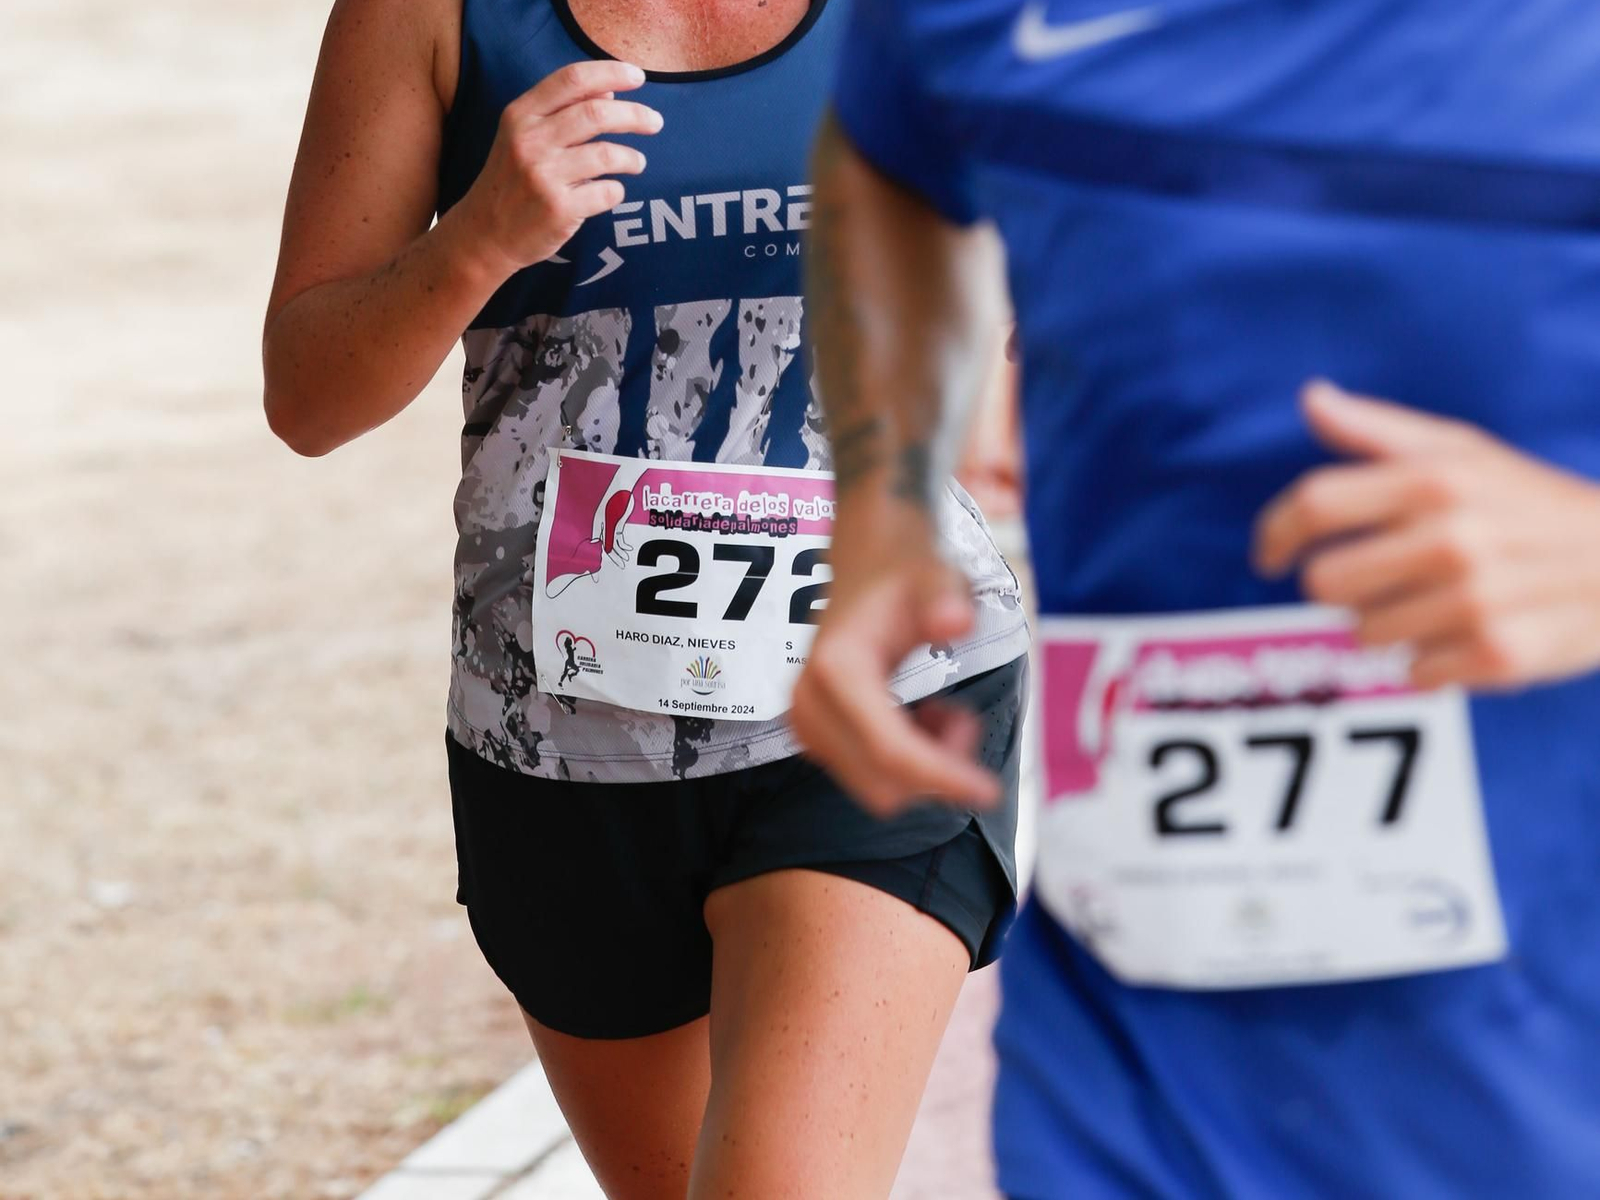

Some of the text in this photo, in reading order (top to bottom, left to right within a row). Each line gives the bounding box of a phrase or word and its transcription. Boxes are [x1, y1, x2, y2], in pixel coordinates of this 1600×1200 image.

[744, 242, 800, 258] COM
[616, 629, 736, 650] HARO DIAZ, NIEVES
[658, 698, 755, 714] 14 Septiembre 2024
[1148, 724, 1422, 837] 277
